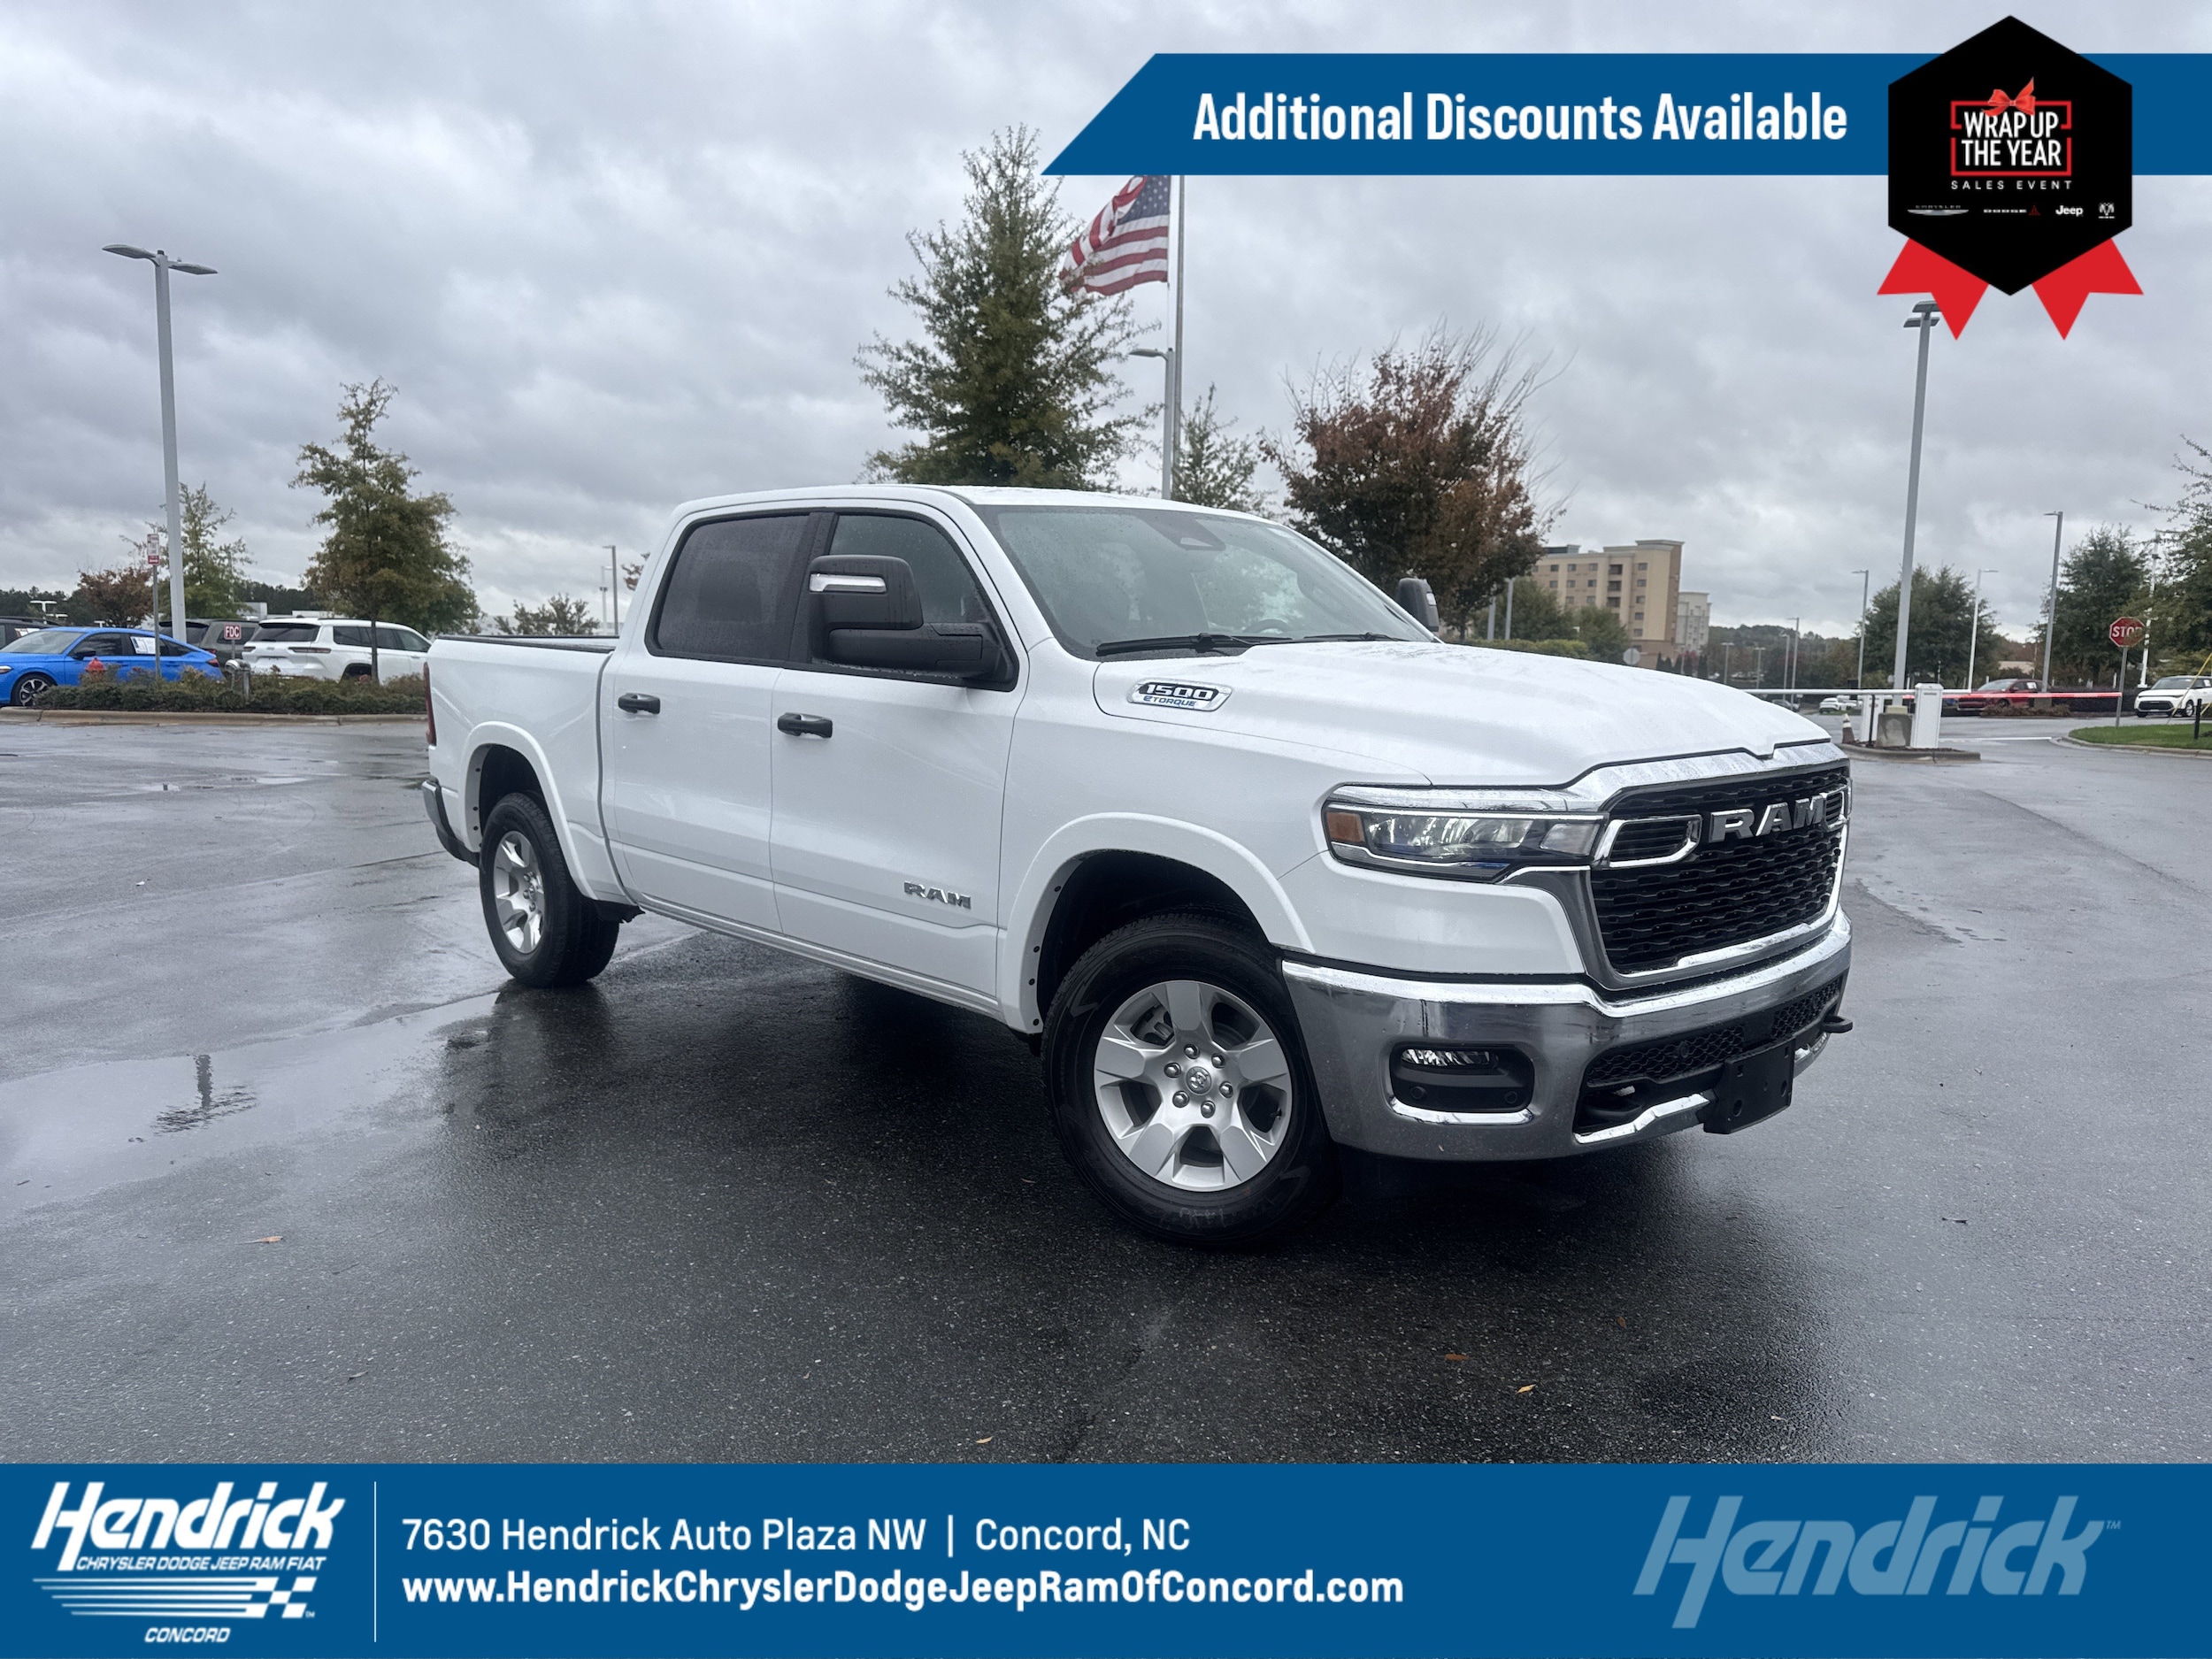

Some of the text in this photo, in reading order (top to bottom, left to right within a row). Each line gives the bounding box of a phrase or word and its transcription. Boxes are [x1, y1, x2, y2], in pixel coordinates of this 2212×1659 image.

[226, 626, 240, 638] FDC
[1146, 684, 1214, 700] 1500
[1709, 795, 1826, 843] RAM
[903, 879, 971, 910] RAM
